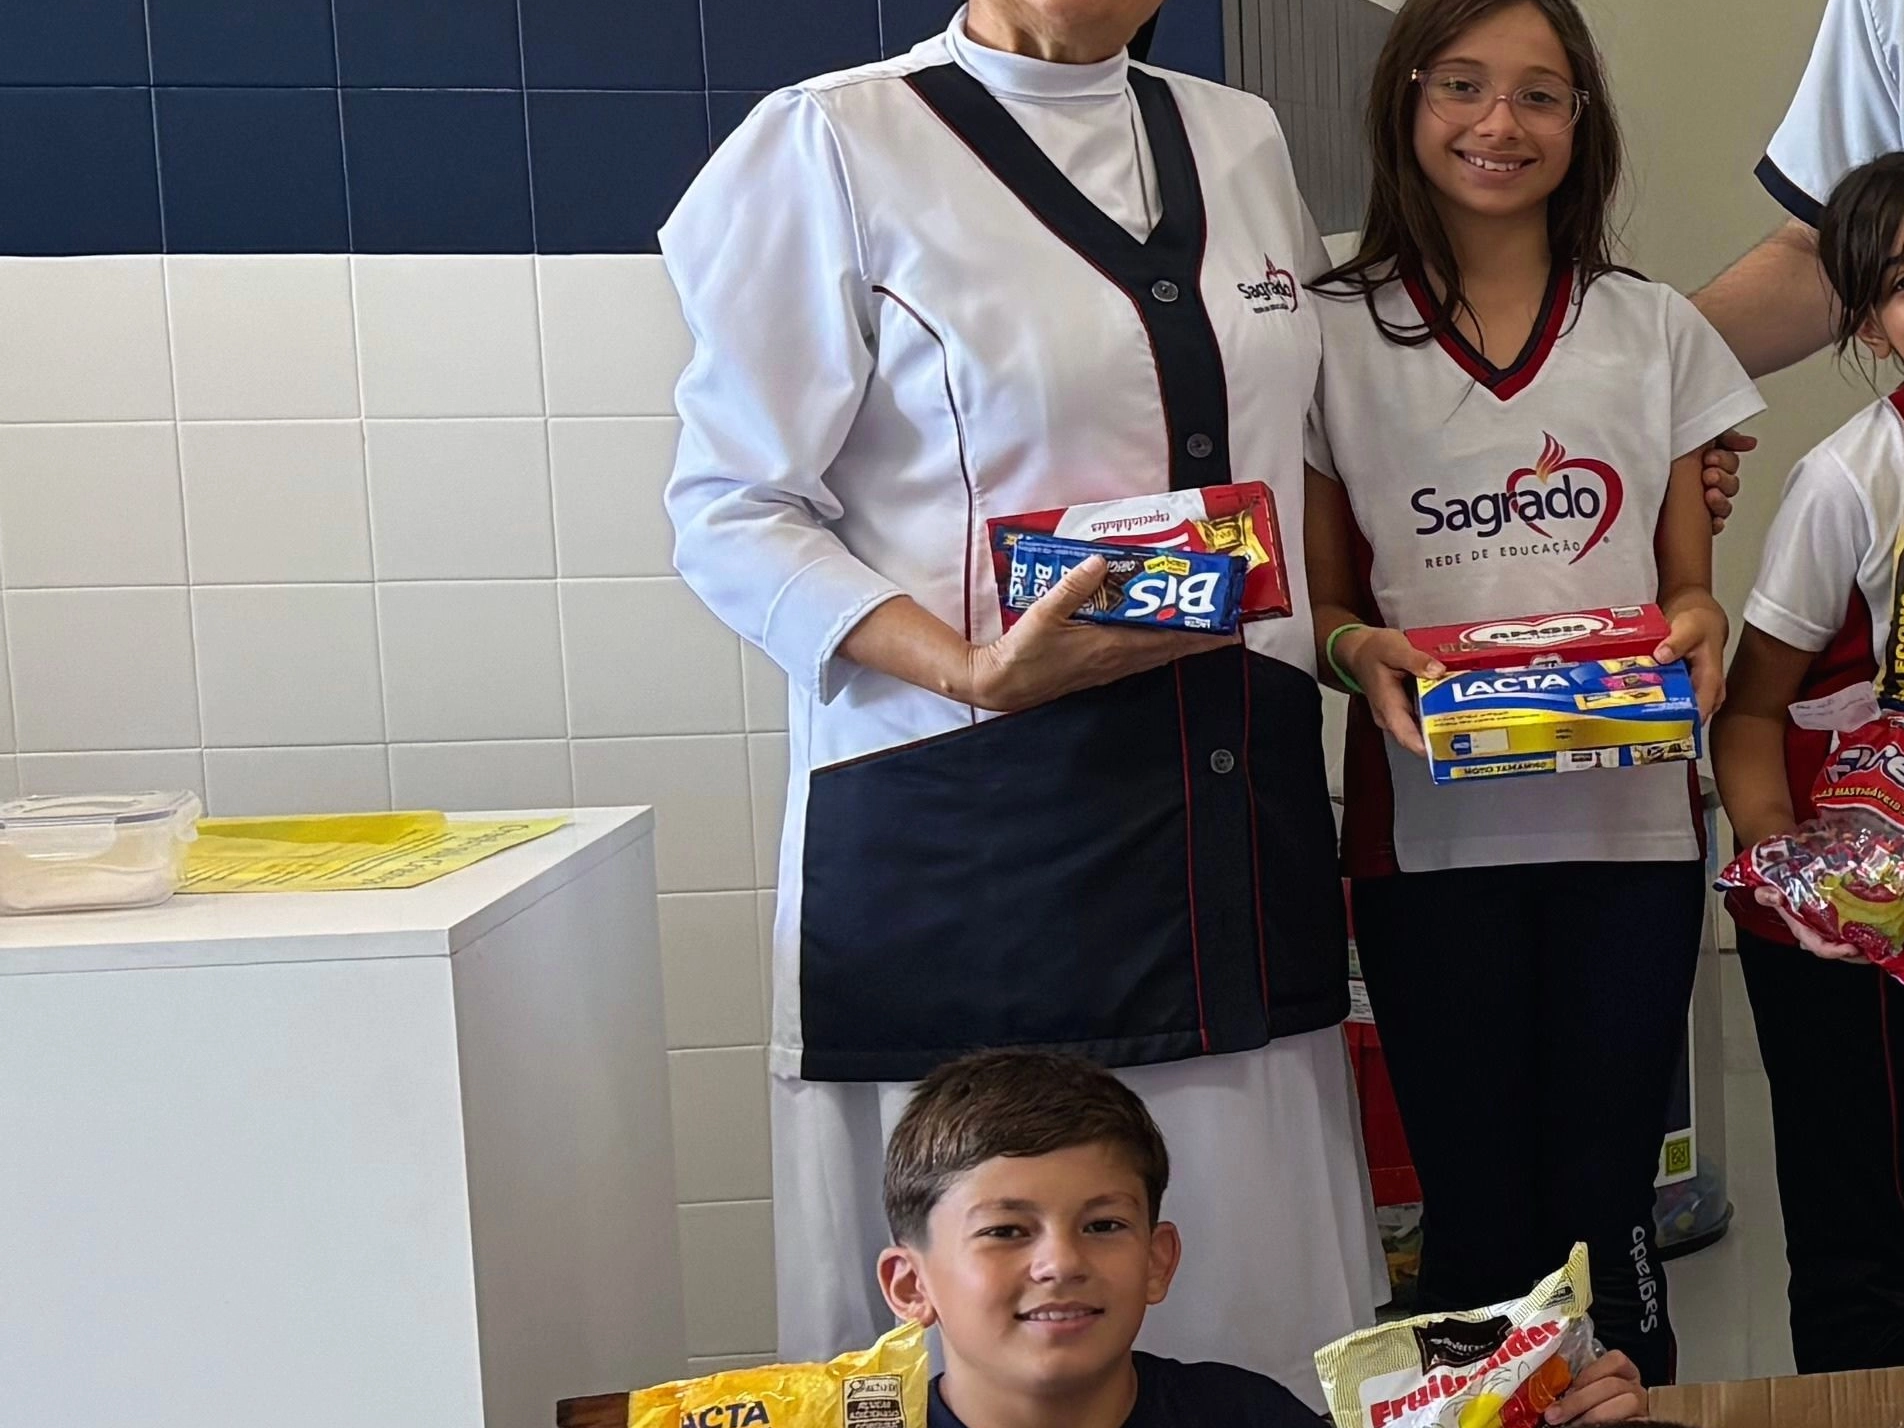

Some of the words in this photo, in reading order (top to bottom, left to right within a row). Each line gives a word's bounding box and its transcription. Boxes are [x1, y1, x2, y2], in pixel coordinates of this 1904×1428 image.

[1237, 278, 1291, 303] Sagrado
[1411, 474, 1599, 538] Sagrado
[1425, 553, 1462, 569] REDE
[1471, 548, 1489, 561] DE
[1500, 539, 1580, 557] EDUCAÇÃO
[1451, 674, 1569, 703] LACTA
[1632, 1226, 1658, 1334] Sagrado
